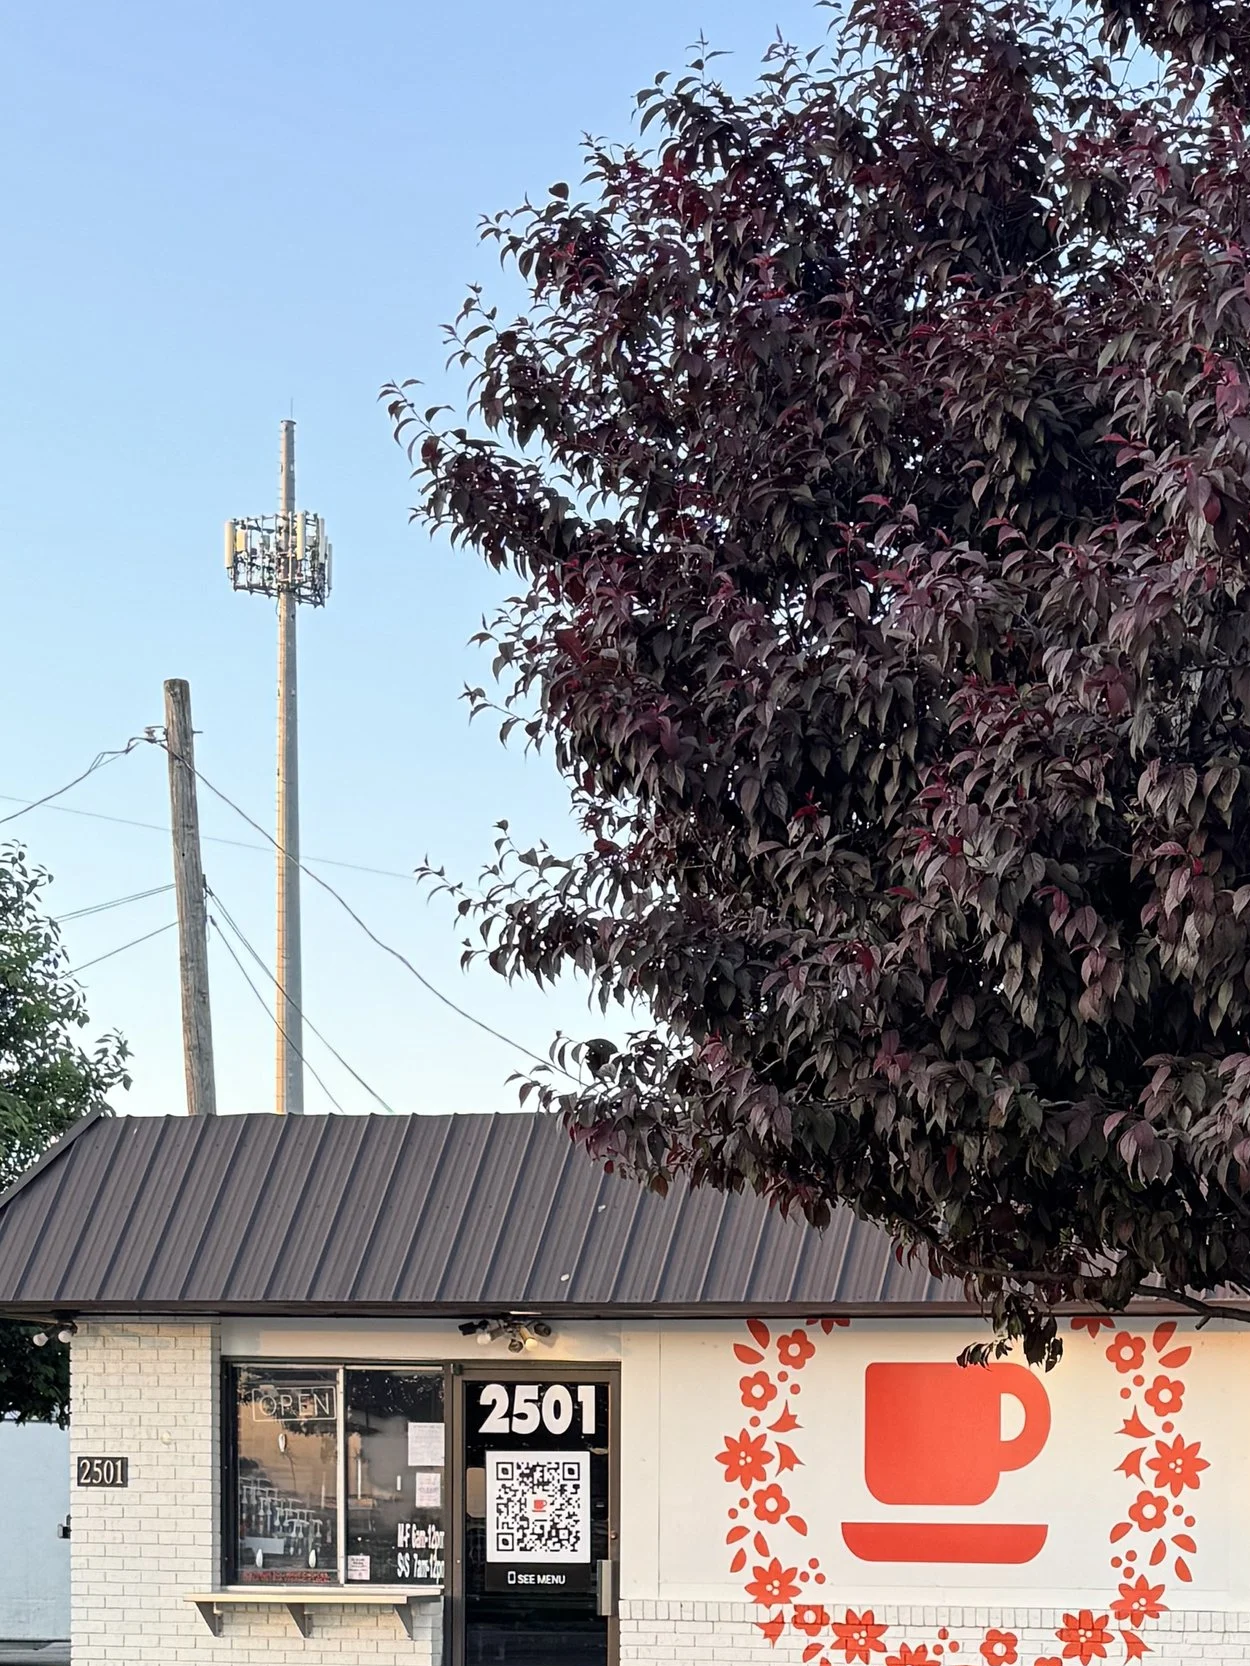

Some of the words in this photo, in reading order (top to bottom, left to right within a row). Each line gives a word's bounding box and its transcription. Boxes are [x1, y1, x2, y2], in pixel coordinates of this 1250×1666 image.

[260, 1392, 330, 1416] OPEN
[478, 1384, 595, 1434] 2501
[80, 1459, 123, 1484] 2501
[397, 1523, 411, 1548] M-F
[517, 1574, 536, 1584] SEE
[537, 1574, 566, 1584] MENU
